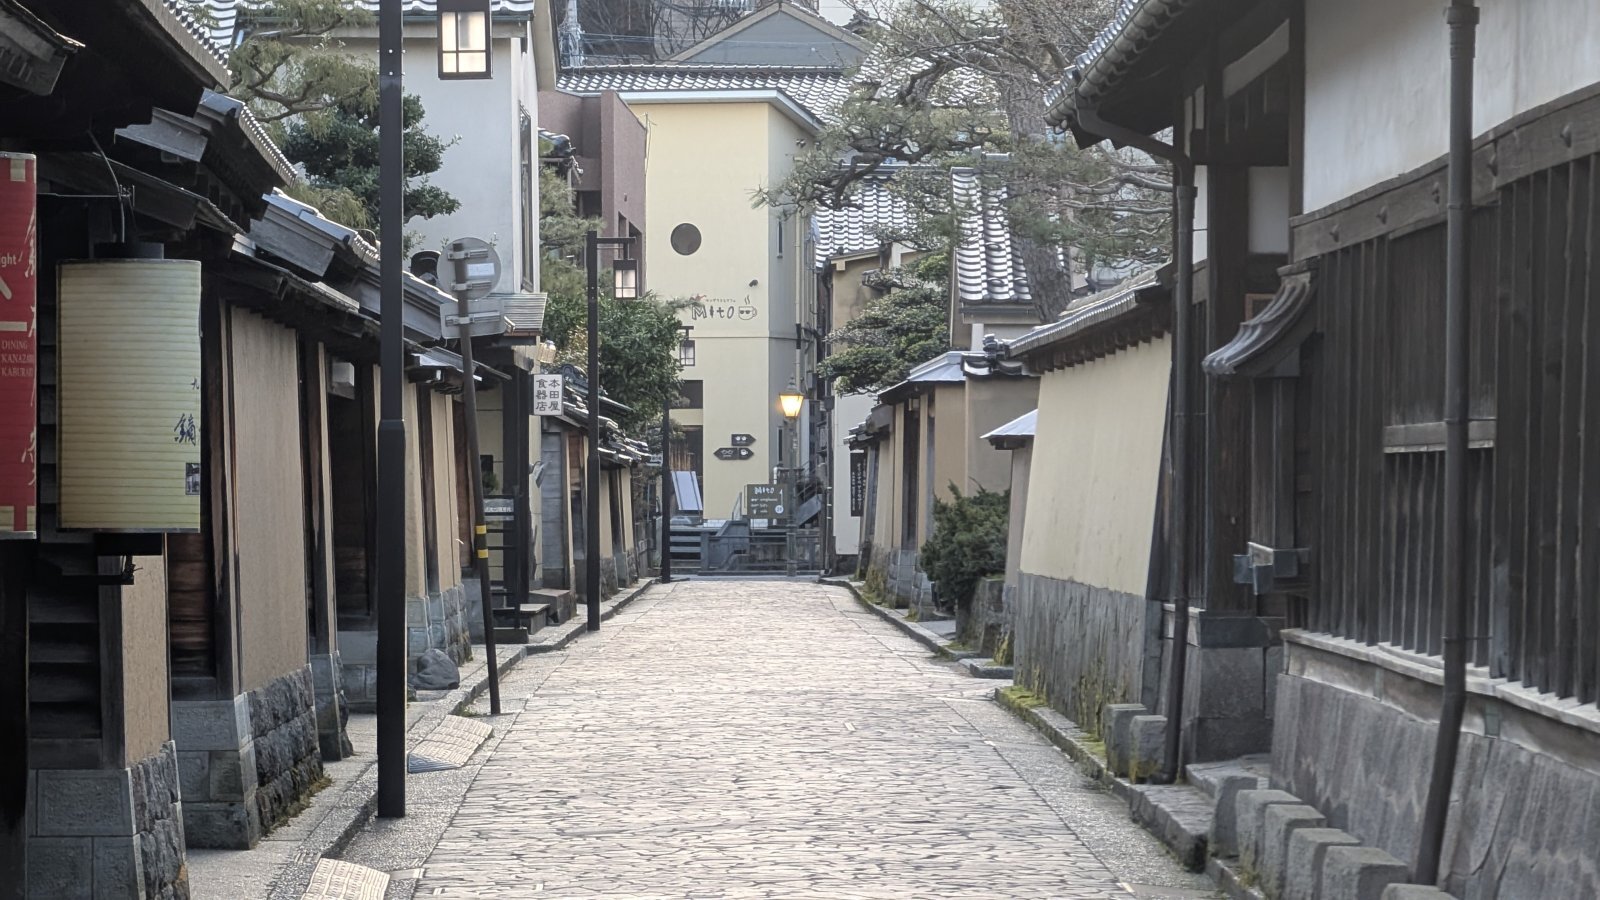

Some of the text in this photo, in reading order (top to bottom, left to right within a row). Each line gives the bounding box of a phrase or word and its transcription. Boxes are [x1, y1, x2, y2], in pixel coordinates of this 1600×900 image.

[1, 339, 28, 350] DINING
[535, 378, 548, 411] 食器店
[548, 378, 560, 411] 本田屋
